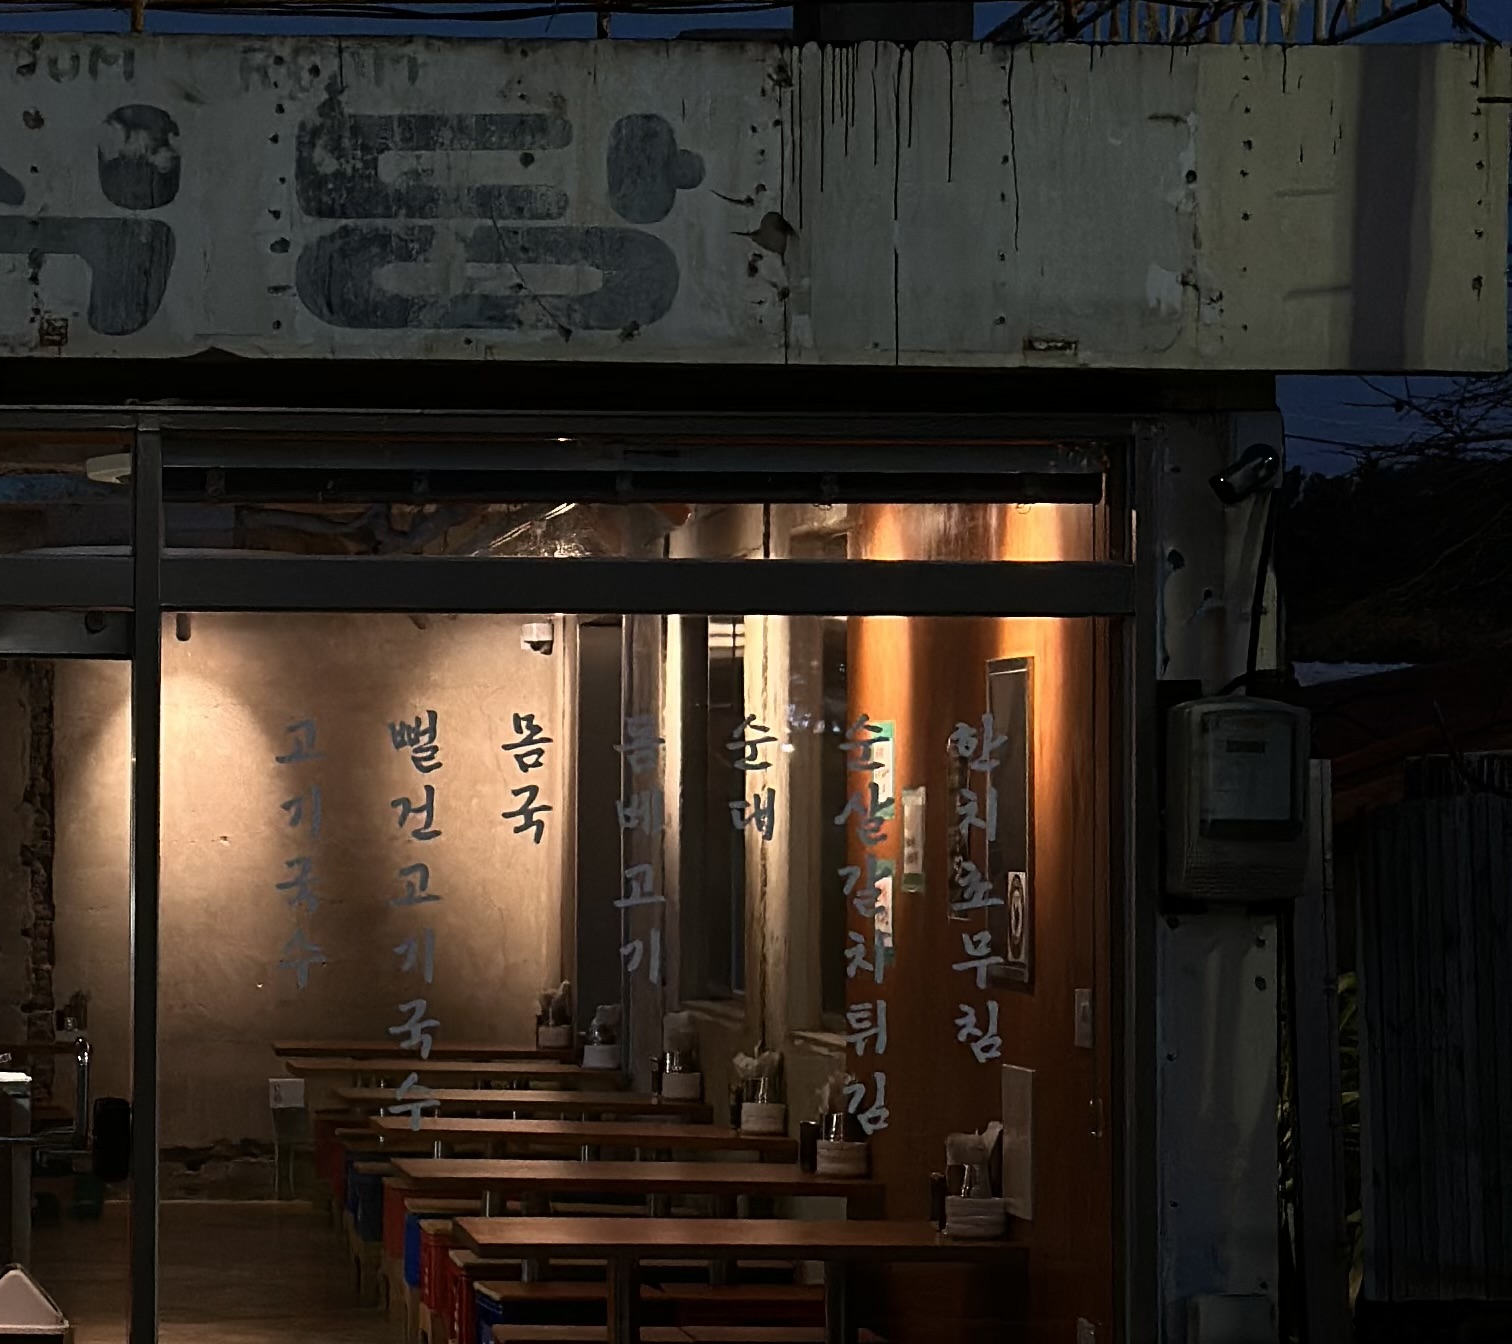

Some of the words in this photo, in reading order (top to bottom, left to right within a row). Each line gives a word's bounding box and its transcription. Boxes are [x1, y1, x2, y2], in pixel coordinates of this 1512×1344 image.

[501, 712, 554, 844] 몸국
[726, 713, 779, 841] 순대
[275, 718, 328, 989] 고기국수
